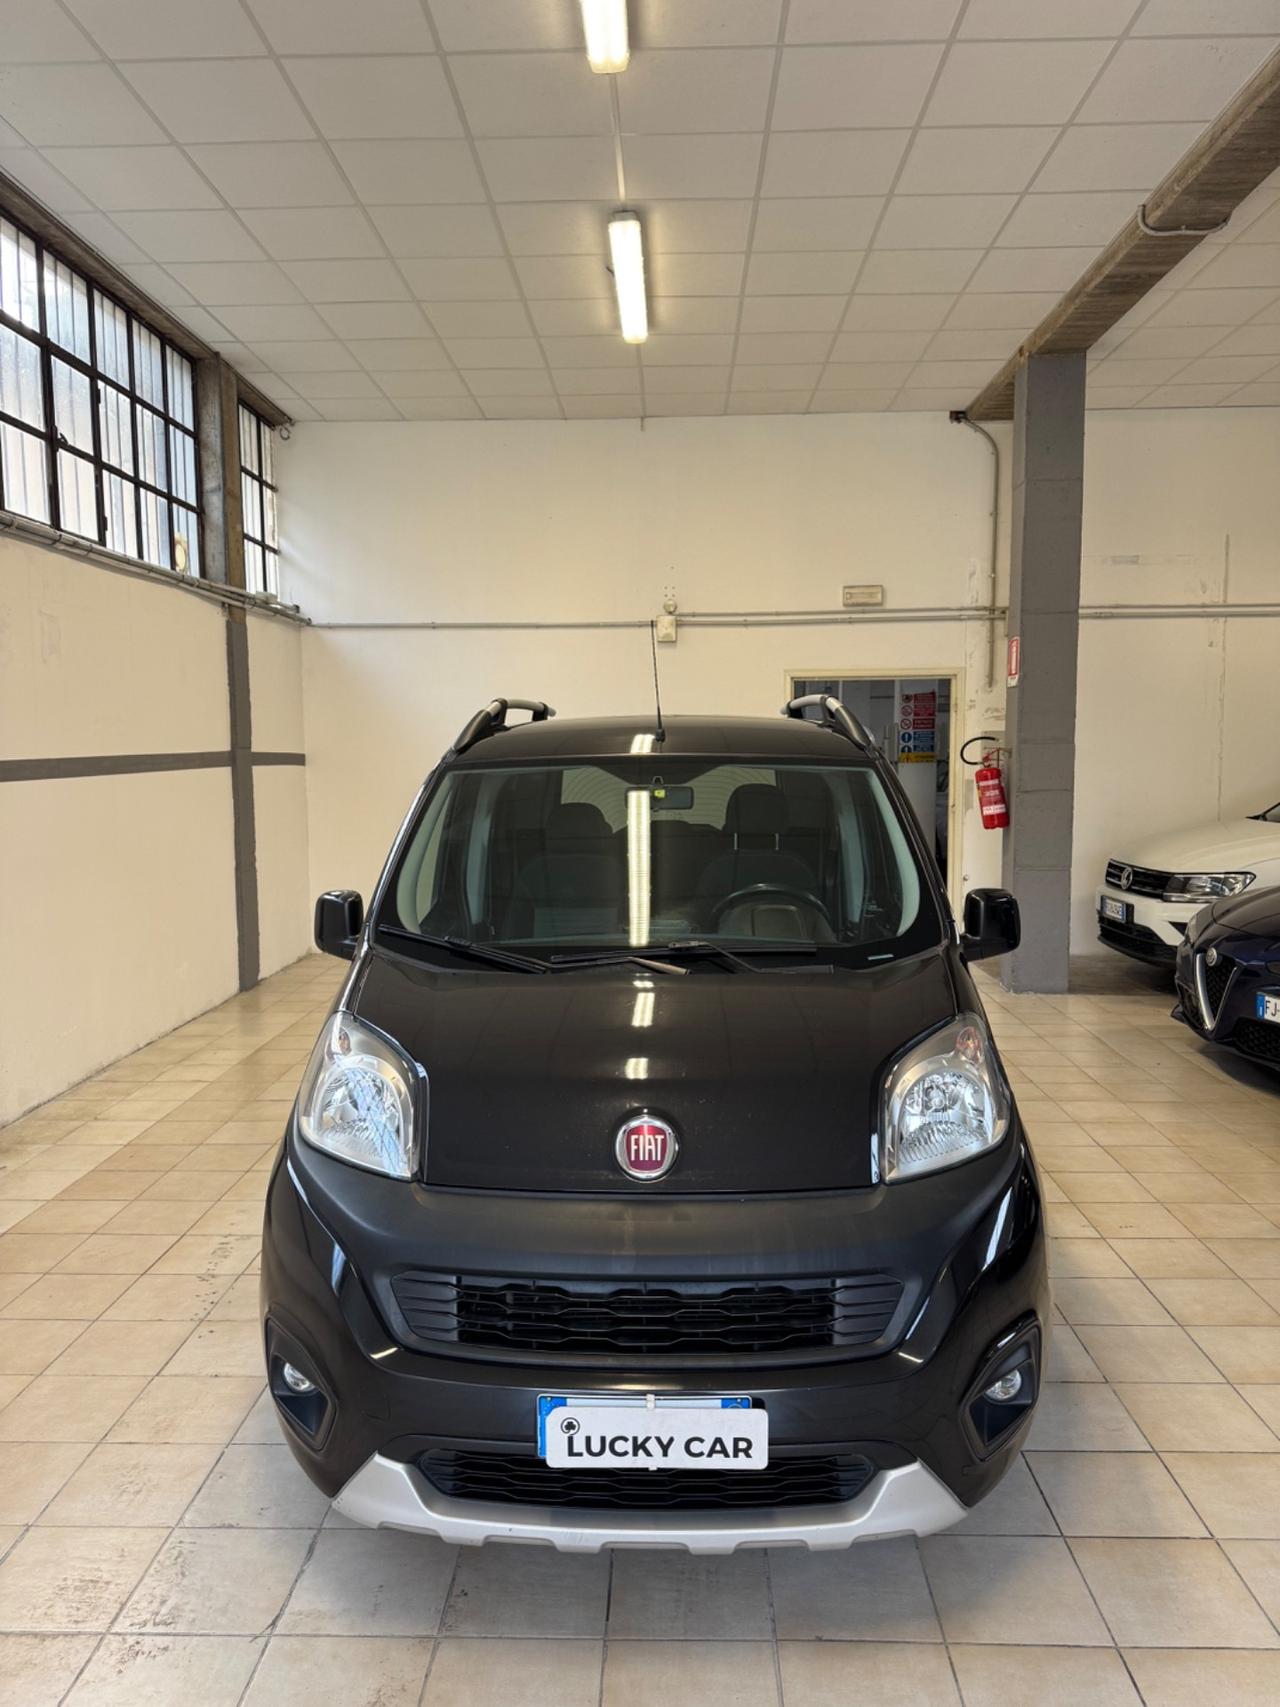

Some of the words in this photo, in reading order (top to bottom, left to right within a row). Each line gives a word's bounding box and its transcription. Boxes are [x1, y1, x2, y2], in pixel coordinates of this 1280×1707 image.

[630, 1134, 665, 1161] FIAT
[567, 1435, 675, 1458] LUCKY
[684, 1436, 753, 1459] CAR
